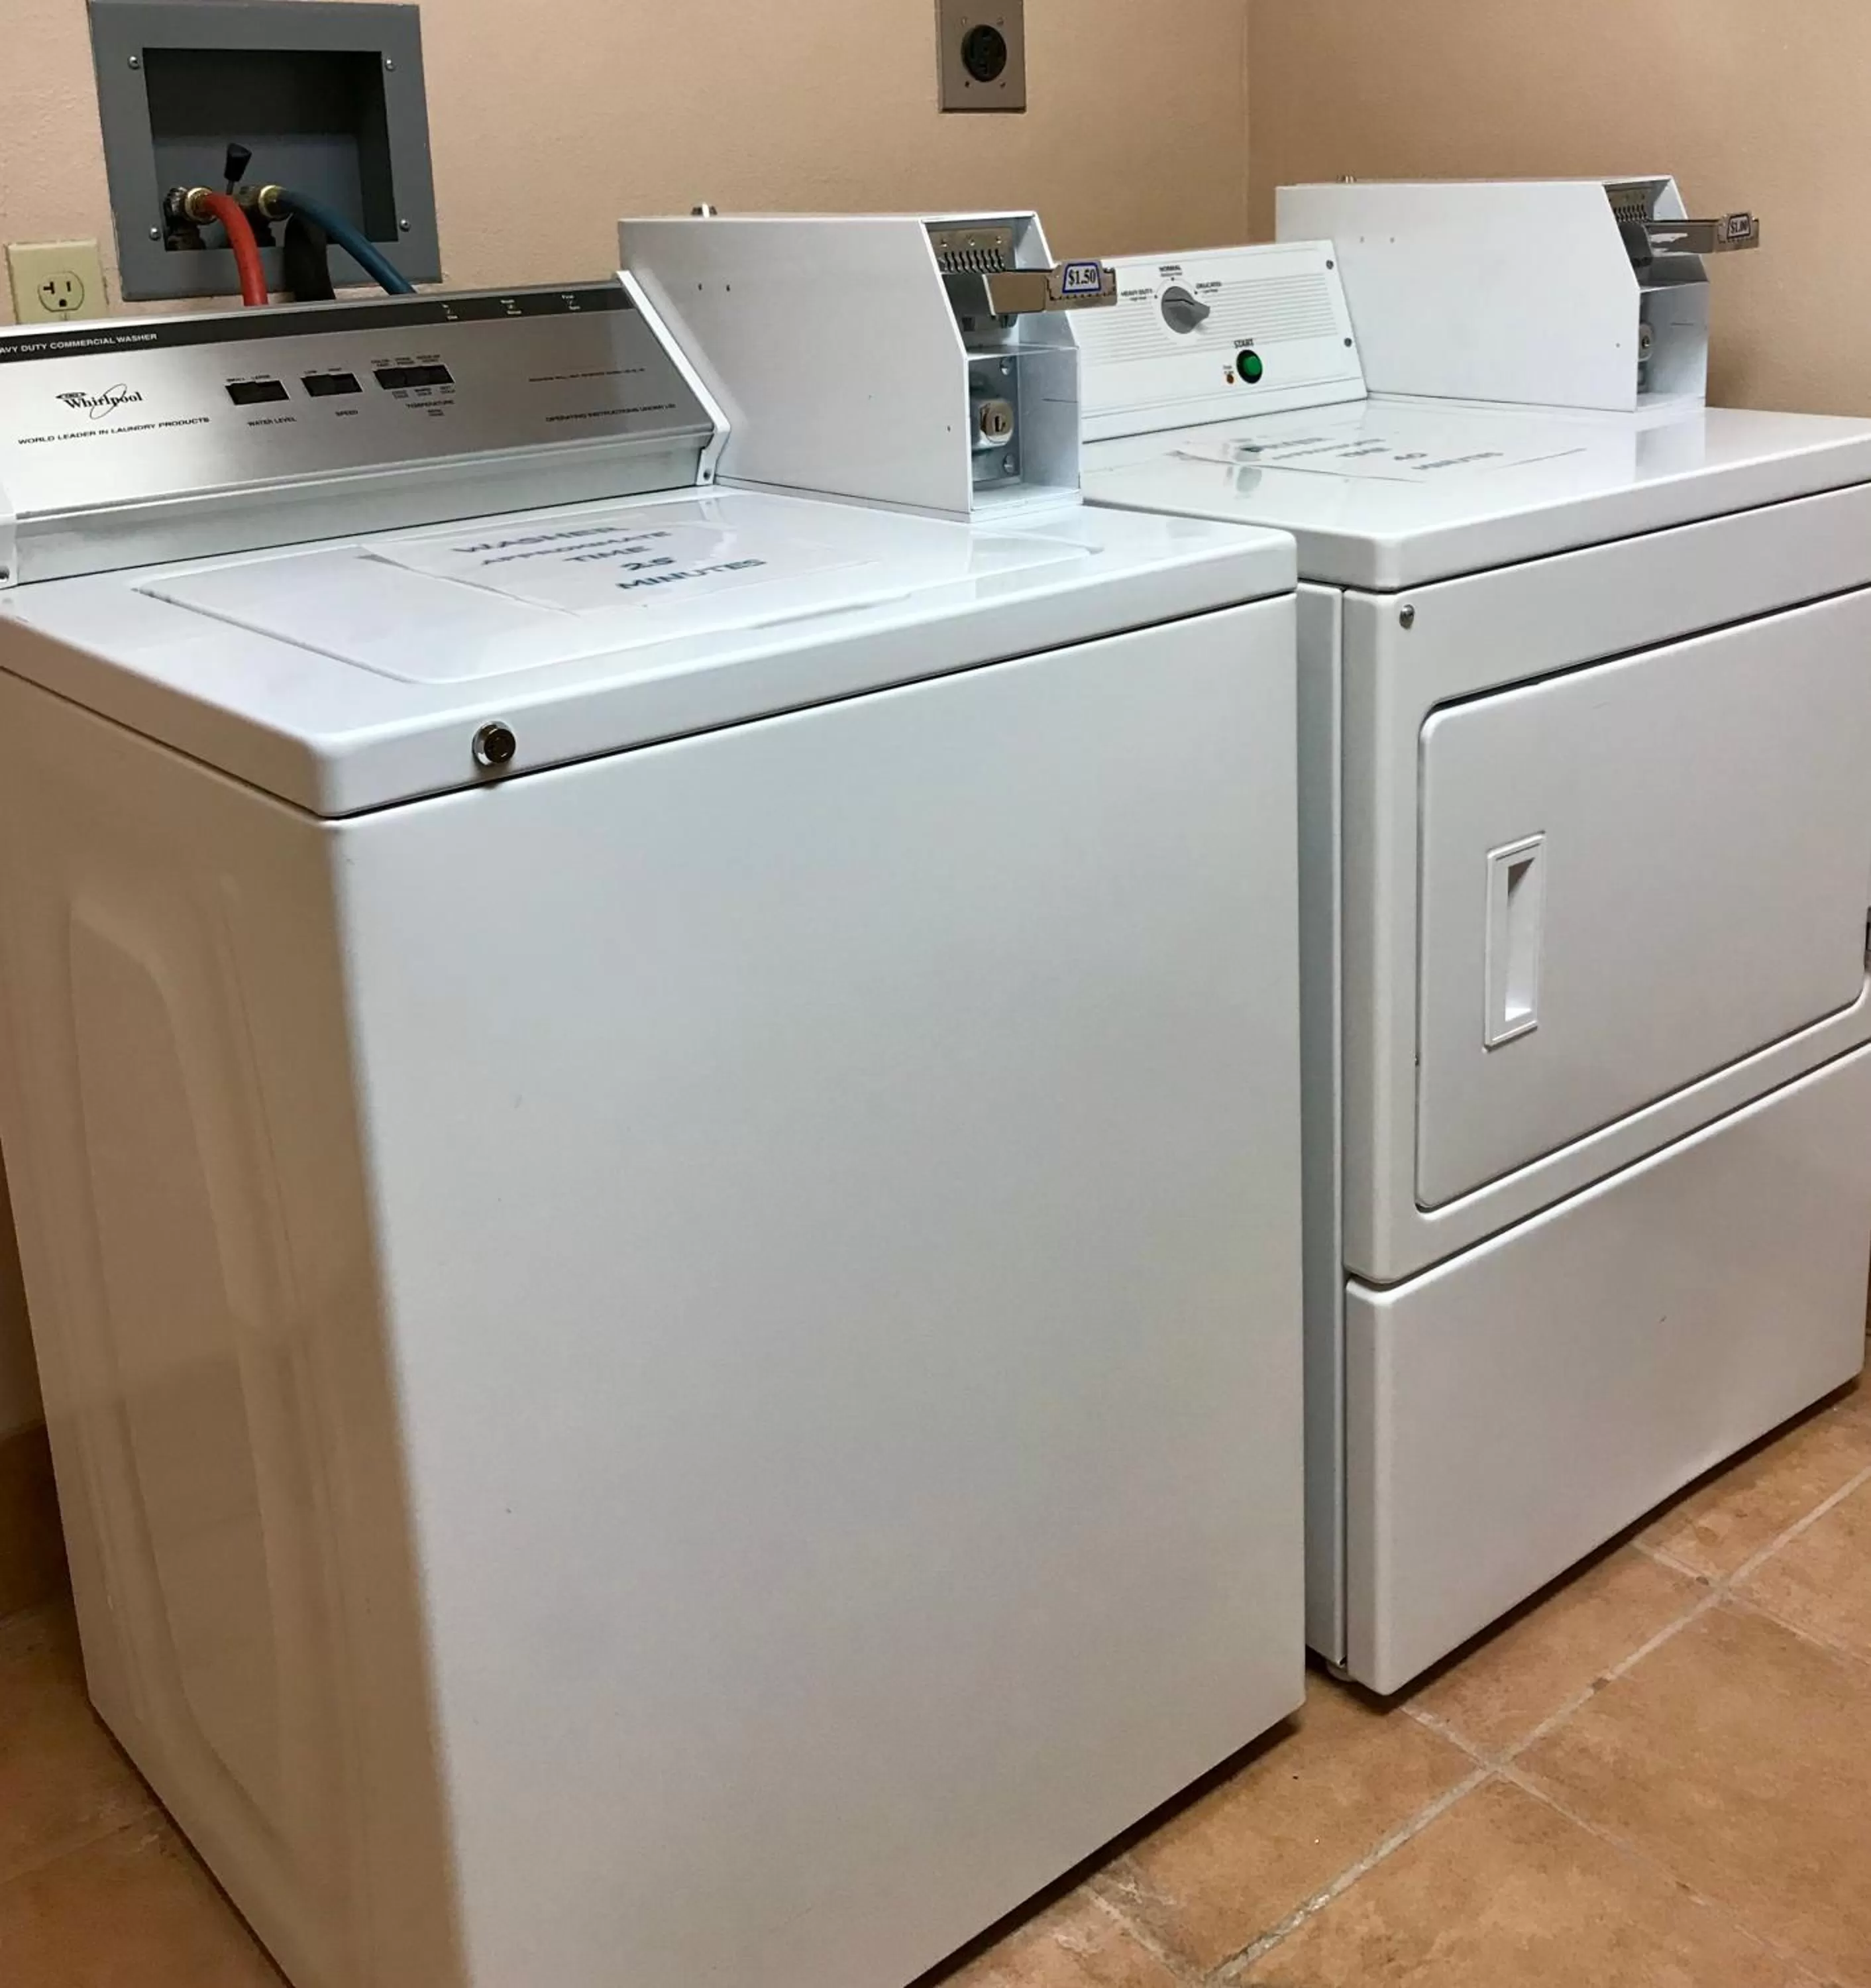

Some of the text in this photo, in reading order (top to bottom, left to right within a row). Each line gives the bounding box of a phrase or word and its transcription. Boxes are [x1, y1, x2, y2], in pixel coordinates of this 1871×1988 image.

[1068, 268, 1096, 286] $1.50
[21, 343, 47, 352] DUTY
[50, 337, 115, 349] COMMERCIAL
[117, 333, 158, 343] WASHER
[1234, 338, 1254, 349] START
[64, 391, 143, 409] Whirlpool
[18, 435, 55, 445] WORLD
[58, 430, 96, 440] LEADER
[111, 423, 156, 434] LAUNDRY
[158, 416, 209, 428] PRODUCTS
[247, 418, 273, 427] WATER
[450, 527, 630, 552] WASHER
[482, 531, 672, 565] APPROXIMATE
[563, 545, 652, 562] TIME
[620, 557, 676, 571] 25
[615, 558, 767, 590] MINUTES
